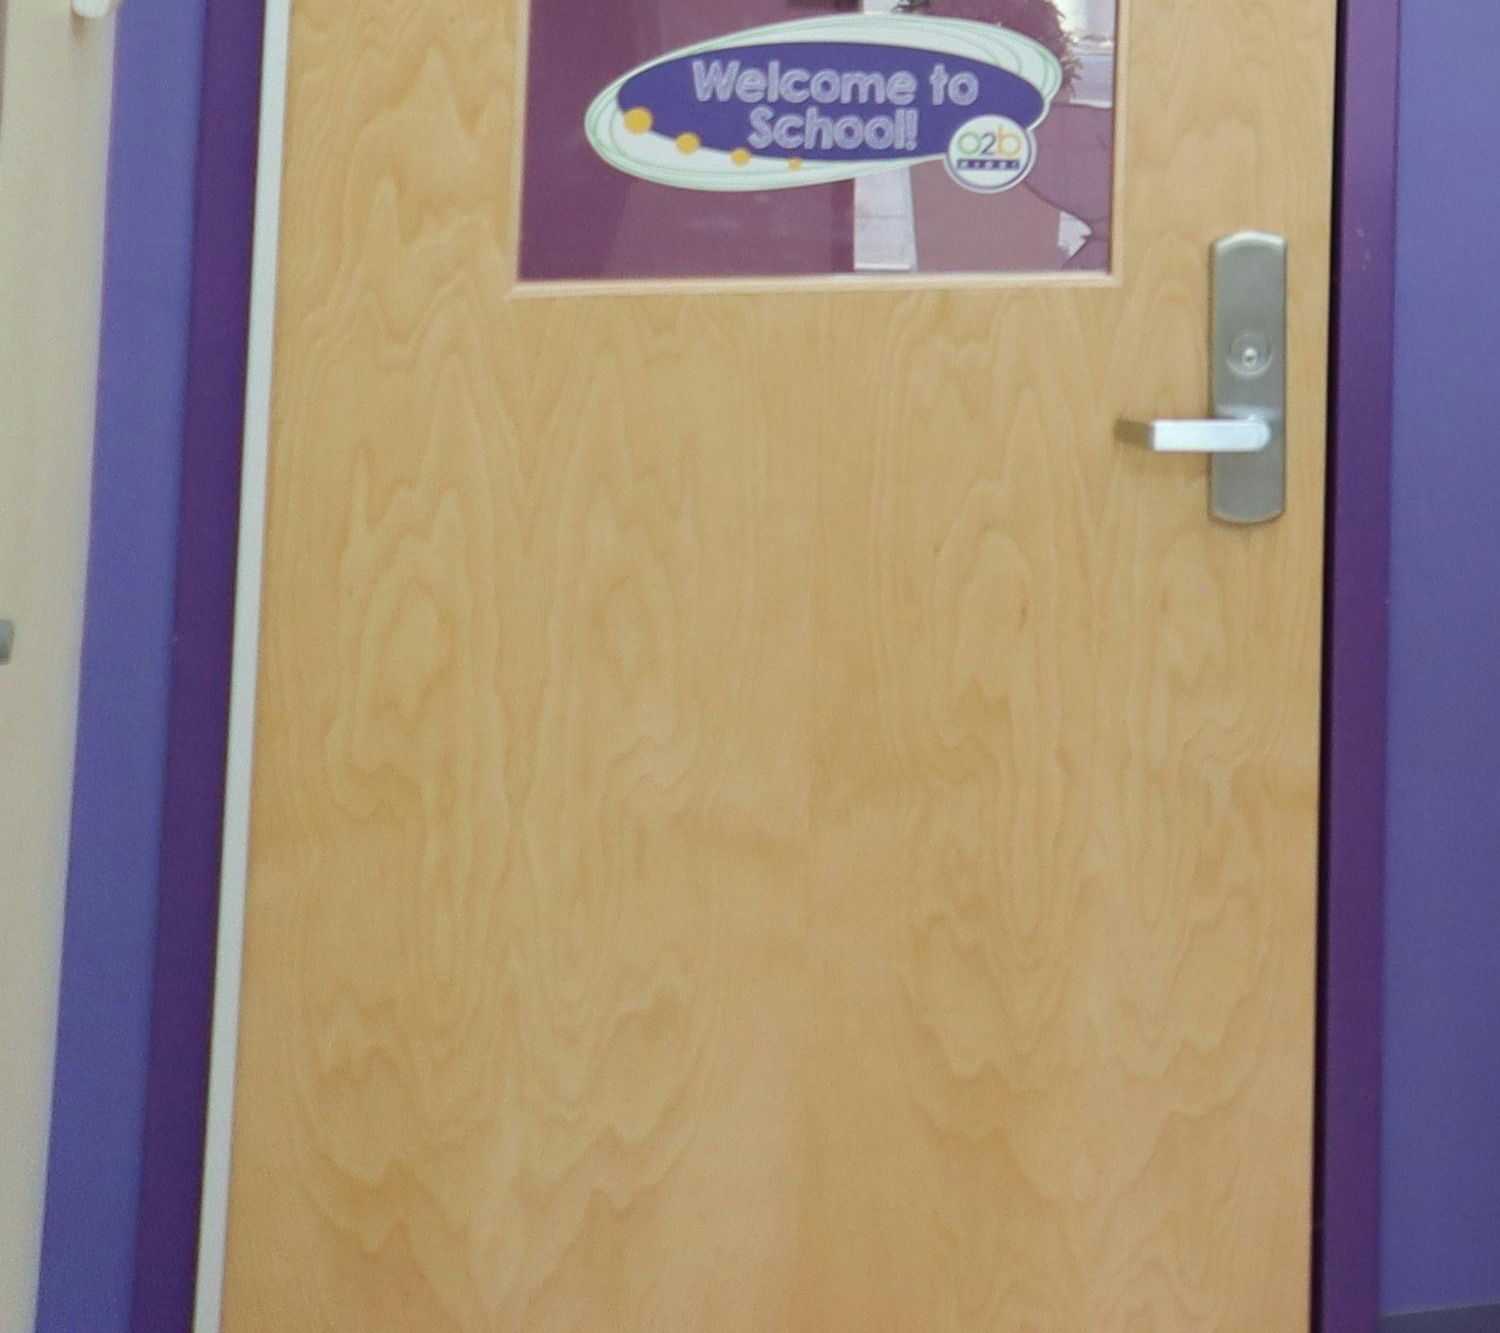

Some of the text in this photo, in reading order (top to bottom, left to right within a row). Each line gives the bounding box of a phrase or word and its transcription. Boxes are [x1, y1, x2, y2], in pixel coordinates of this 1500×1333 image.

[691, 59, 980, 106] Welcome to
[747, 106, 919, 151] School!
